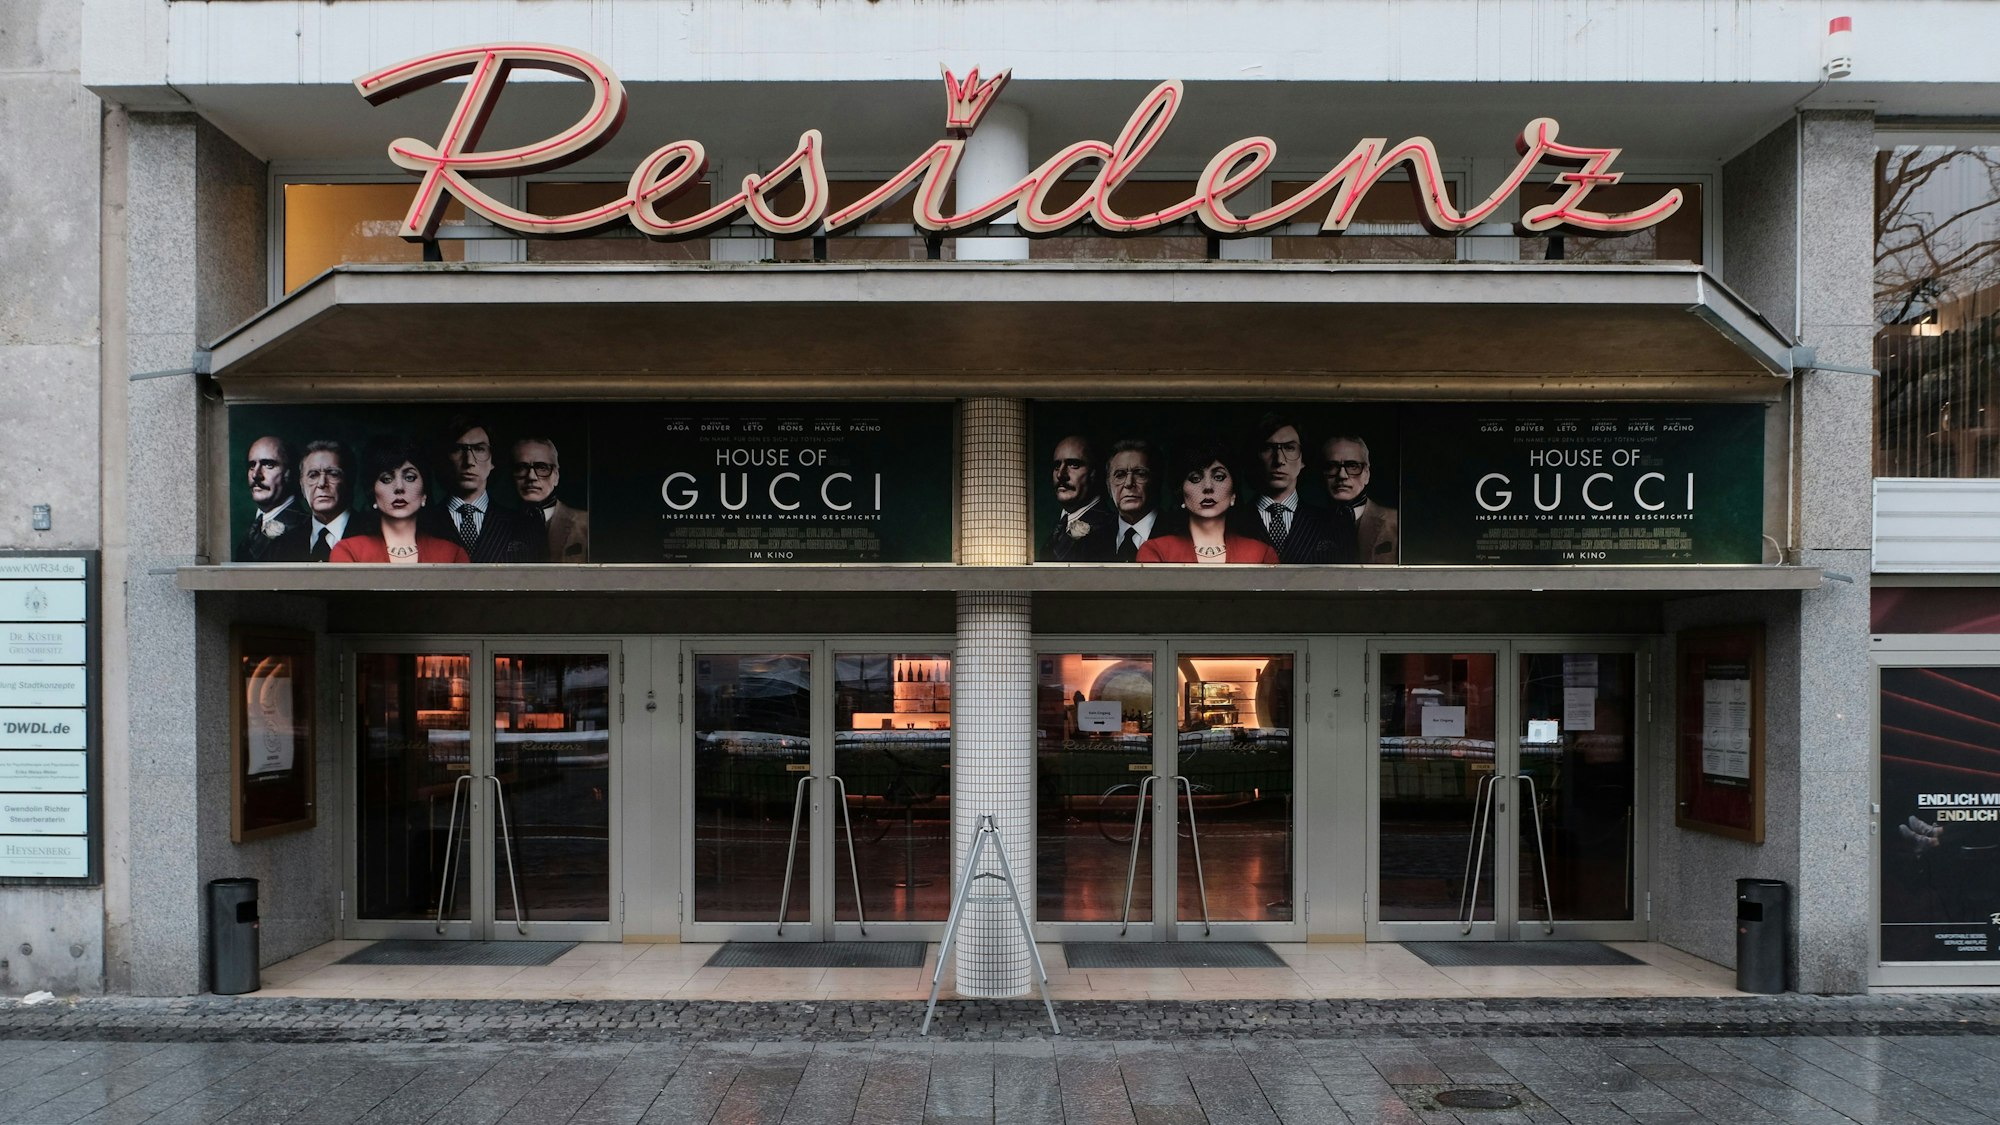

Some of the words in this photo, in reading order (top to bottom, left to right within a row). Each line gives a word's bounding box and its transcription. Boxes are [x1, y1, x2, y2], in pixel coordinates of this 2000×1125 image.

[353, 42, 1683, 242] Residenz
[716, 448, 789, 466] HOUSE
[798, 448, 827, 466] OF
[1530, 449, 1603, 467] HOUSE
[1611, 449, 1641, 467] OF
[661, 471, 882, 511] GUCCI
[1474, 472, 1694, 512] GUCCI
[749, 551, 762, 559] IM
[767, 551, 794, 559] KINO
[1562, 551, 1575, 559] IM
[1579, 551, 1607, 559] KINO
[0, 563, 75, 573] www.KWR34.de
[19, 681, 76, 690] Stadtkonzepte
[520, 739, 584, 751] Residenz
[1061, 739, 1125, 751] Residenz
[1918, 794, 1979, 806] ENDLICH
[4, 805, 43, 813] Gwendolin
[44, 805, 71, 813] Richter
[10, 816, 66, 824] Steuerberaterin
[1937, 810, 1998, 822] ENDLICH
[6, 845, 72, 856] HEYSENBERG
